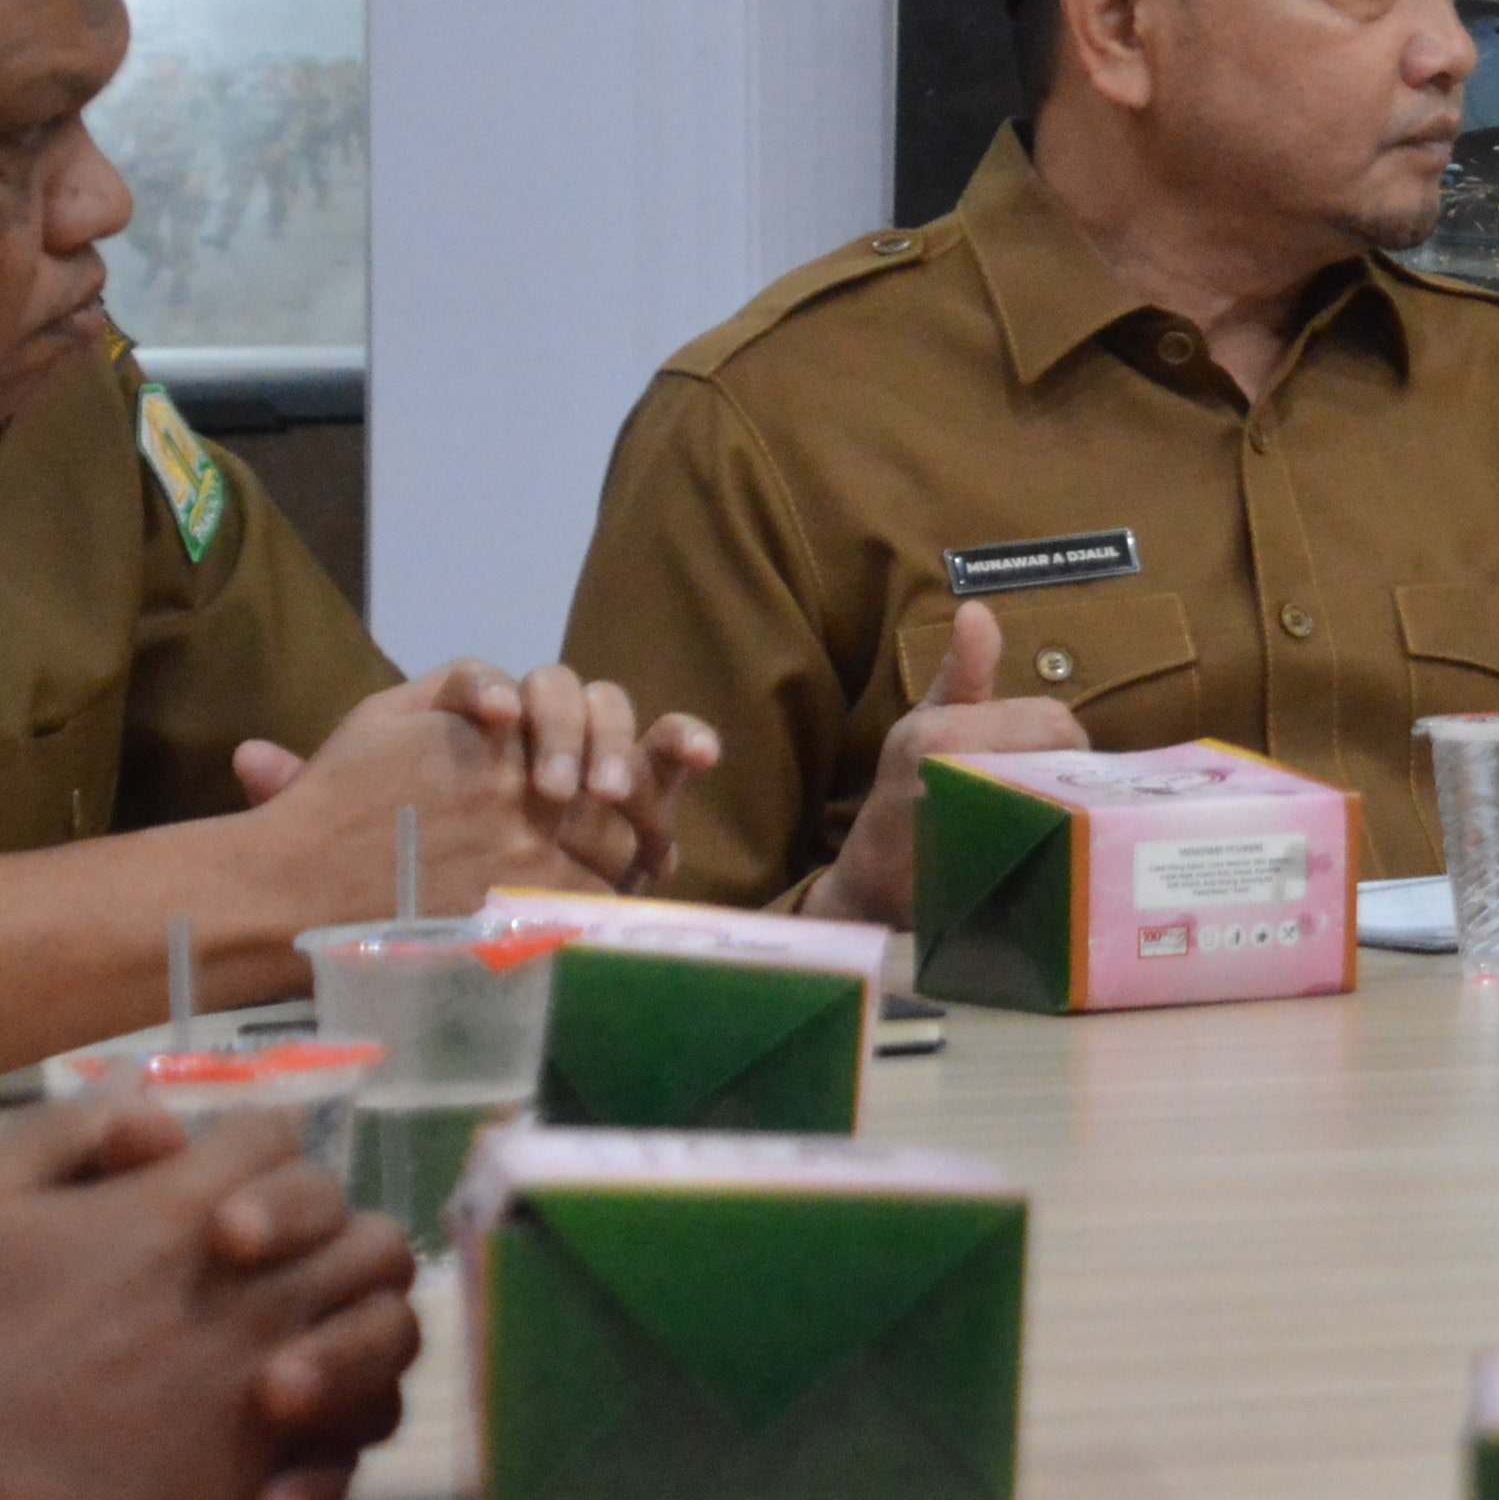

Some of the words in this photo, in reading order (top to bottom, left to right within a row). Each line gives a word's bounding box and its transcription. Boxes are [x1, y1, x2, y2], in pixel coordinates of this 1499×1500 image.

[966, 552, 1050, 574] MUNAWAR
[1052, 551, 1065, 564] A
[1066, 545, 1120, 562] DJALIL
